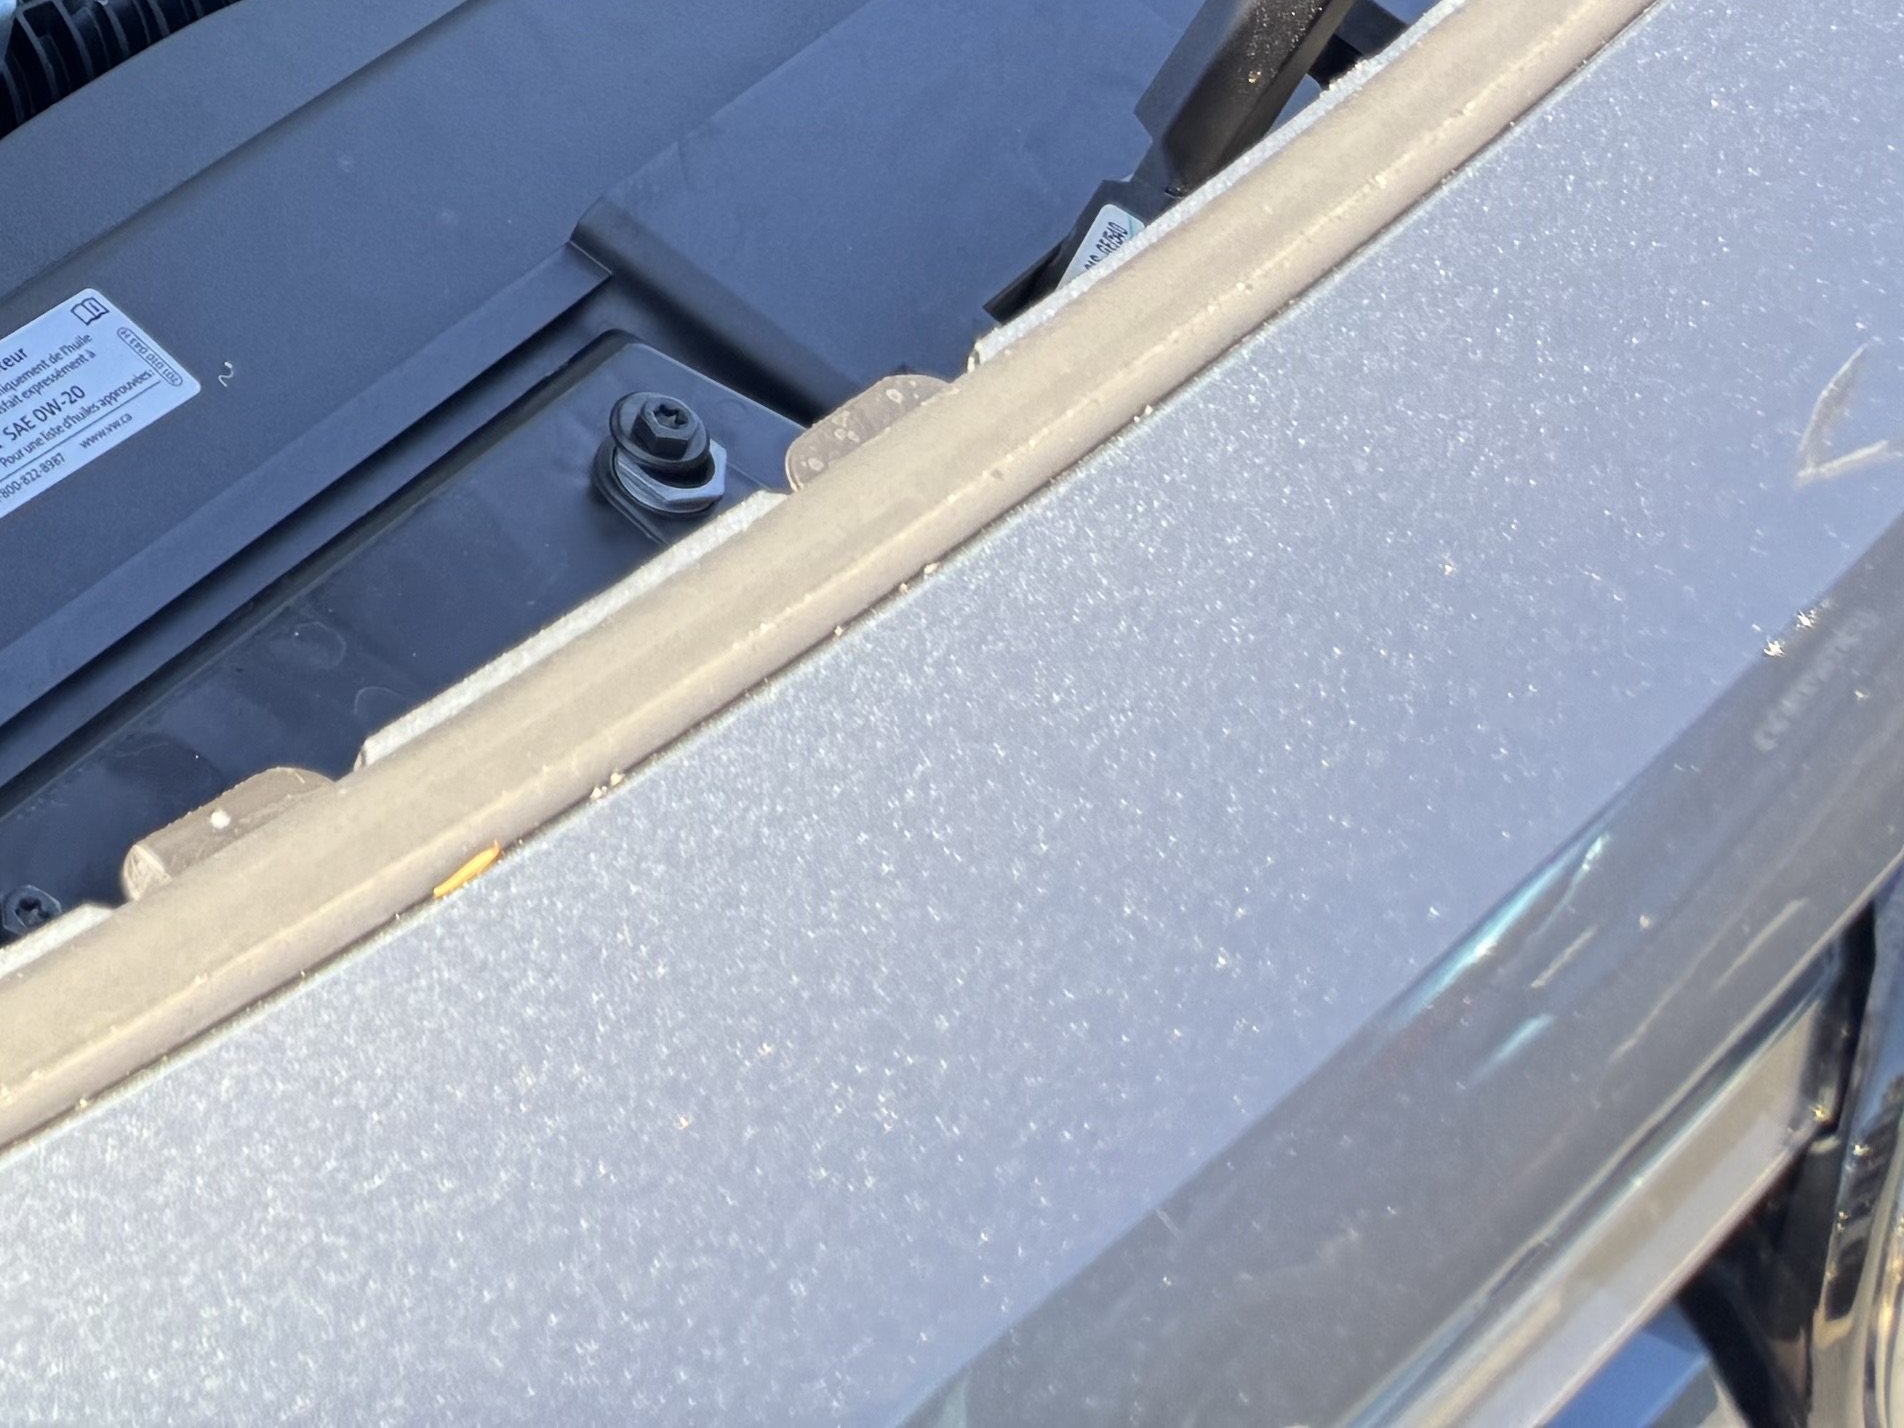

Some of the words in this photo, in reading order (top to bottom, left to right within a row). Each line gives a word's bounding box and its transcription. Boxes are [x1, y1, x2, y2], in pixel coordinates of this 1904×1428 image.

[17, 352, 91, 401] expressément
[84, 348, 97, 358] à
[44, 350, 64, 364] de
[58, 332, 94, 356] l'huile
[1, 415, 37, 442] SAE
[29, 383, 88, 423] 0W-20
[22, 436, 46, 454] une
[39, 422, 67, 442] liste
[58, 400, 101, 430] d'huiles
[94, 366, 157, 409] approuvées:
[77, 411, 134, 450] www.vw.ca
